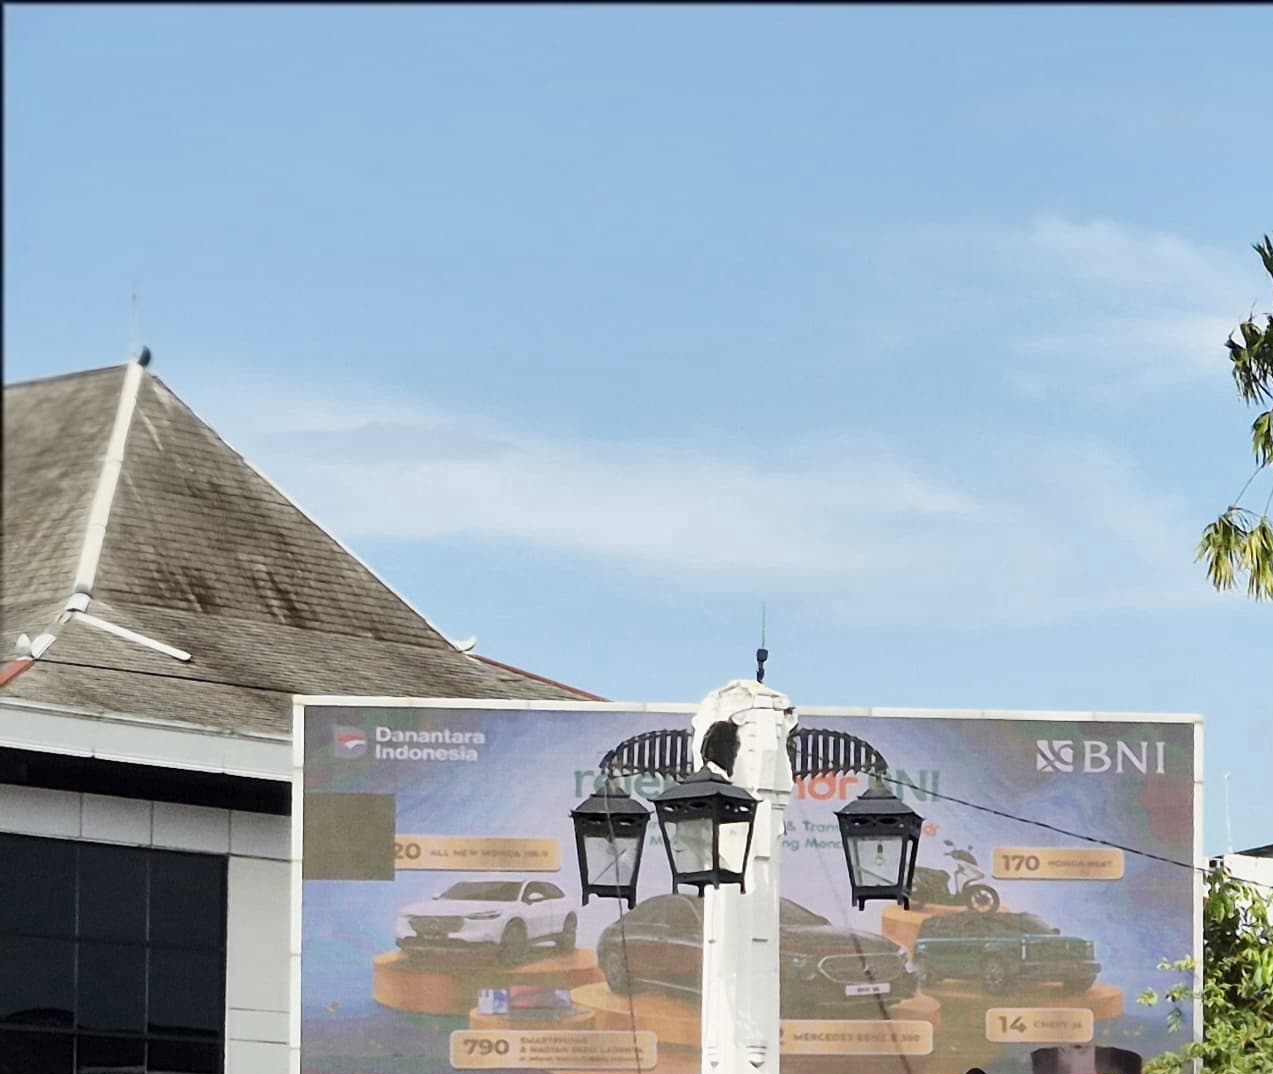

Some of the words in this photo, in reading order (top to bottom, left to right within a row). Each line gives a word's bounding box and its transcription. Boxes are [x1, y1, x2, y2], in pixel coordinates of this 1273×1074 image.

[375, 726, 486, 745] Danantara
[375, 744, 479, 761] Indonesia
[1082, 739, 1167, 775] BNI
[803, 821, 841, 833] Tran
[1001, 854, 1040, 871] 170
[997, 1015, 1027, 1033] 14
[463, 1038, 510, 1055] 790
